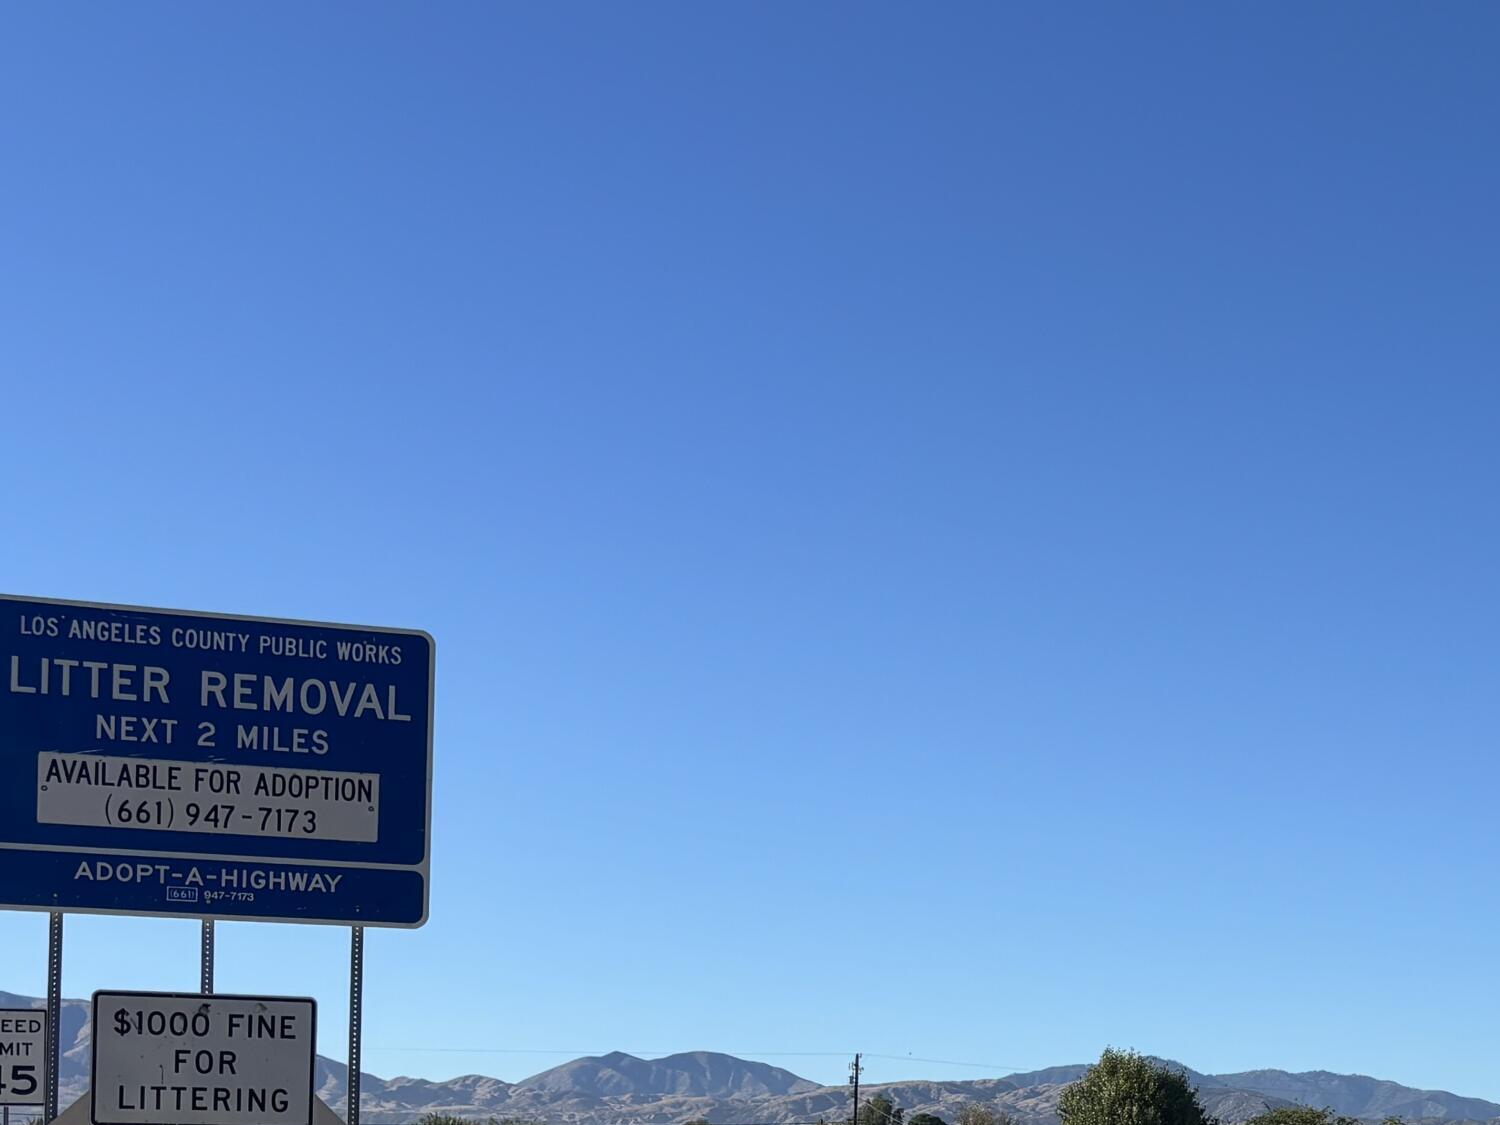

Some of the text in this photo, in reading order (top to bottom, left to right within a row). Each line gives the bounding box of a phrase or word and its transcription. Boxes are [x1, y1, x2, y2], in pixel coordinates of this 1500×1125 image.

[20, 615, 402, 665] LOS ANGELES COUNTY PUBLIC WORKS
[10, 655, 411, 722] LITTER REMOVAL
[96, 715, 330, 755] NEXT 2 MILES
[45, 759, 372, 803] AVAILABLE FOR ADOPTION
[105, 793, 318, 834] (661) 947-7173
[74, 861, 343, 893] ADOPT-A-HIGHWAY
[170, 889, 254, 902] (661) 947-7173
[1, 1019, 42, 1033] EED
[113, 1007, 297, 1040] $1000 FINE
[0, 1042, 33, 1056] MIT
[174, 1050, 237, 1075] FOR
[118, 1085, 289, 1113] LITTERING
